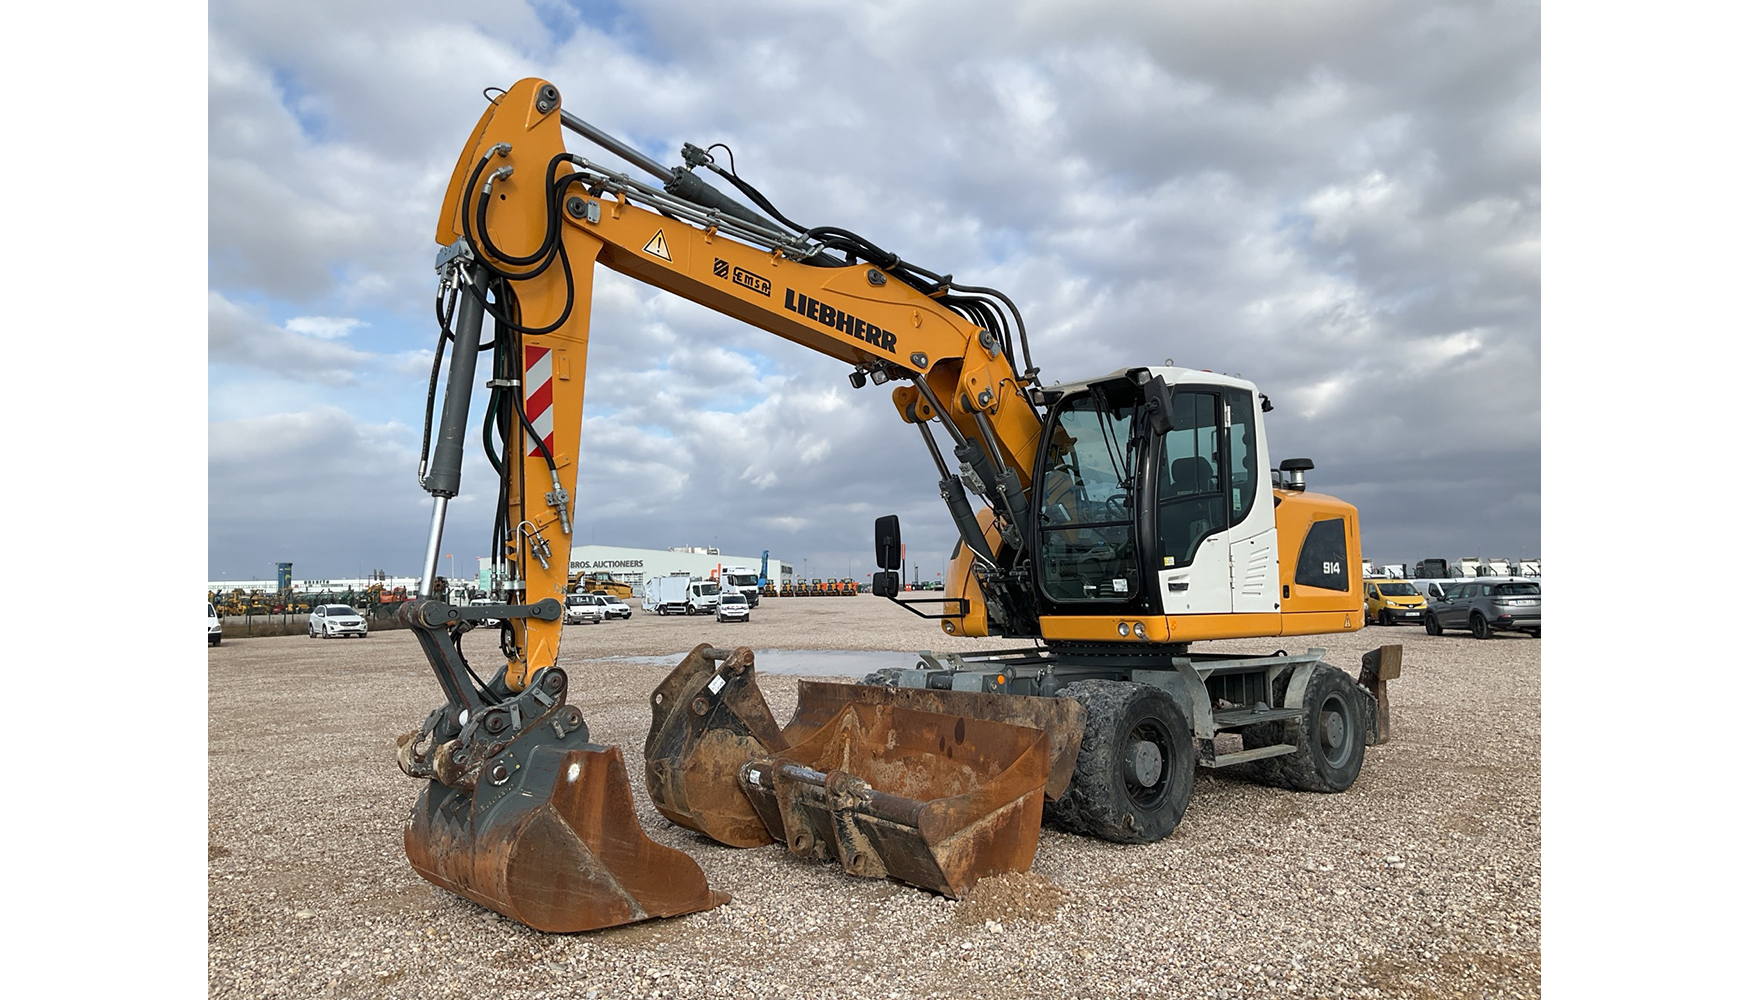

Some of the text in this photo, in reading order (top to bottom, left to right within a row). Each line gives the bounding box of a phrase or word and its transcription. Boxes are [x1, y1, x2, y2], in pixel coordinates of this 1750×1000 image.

[734, 268, 771, 295] EMSA
[784, 287, 897, 354] LIEBHERR
[570, 560, 644, 569] BROS. AUCTIONEERS
[1323, 561, 1340, 574] 914
